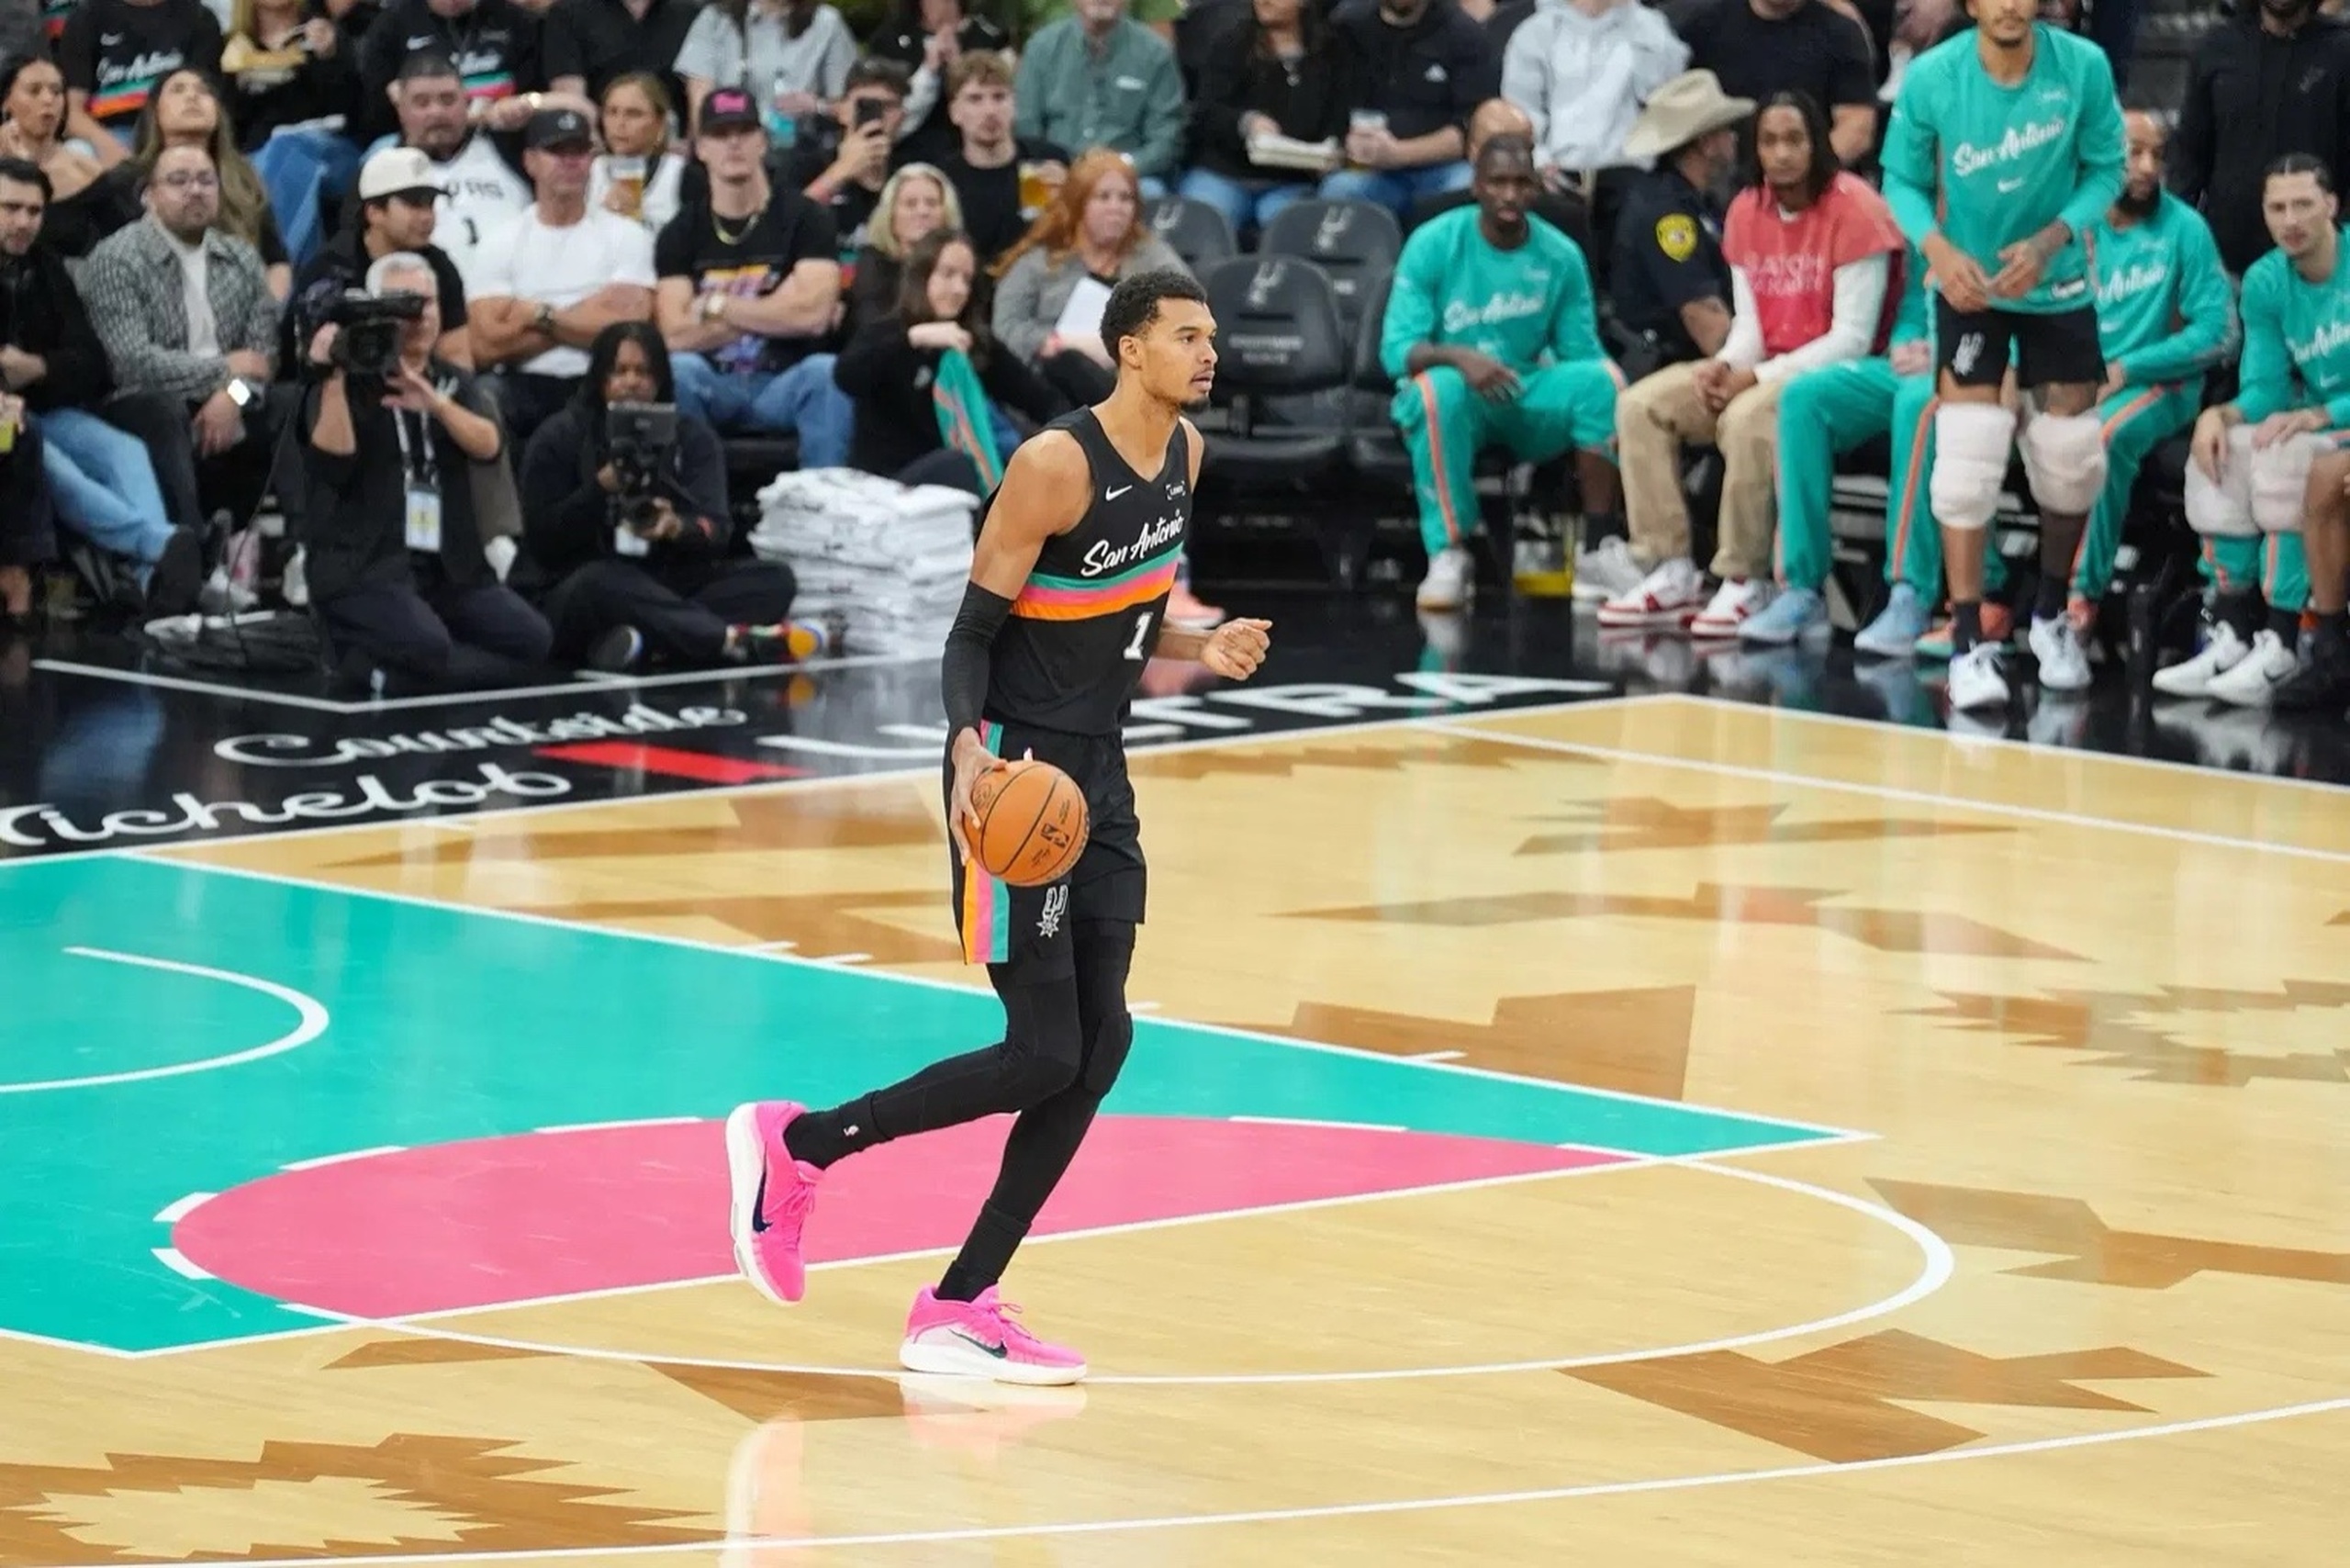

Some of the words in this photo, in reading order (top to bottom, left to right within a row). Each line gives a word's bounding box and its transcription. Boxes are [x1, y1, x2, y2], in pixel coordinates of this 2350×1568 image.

[1953, 141, 1995, 177] San
[1080, 539, 1128, 577] San
[1129, 509, 1185, 561] Antonio
[1123, 611, 1154, 660] 1
